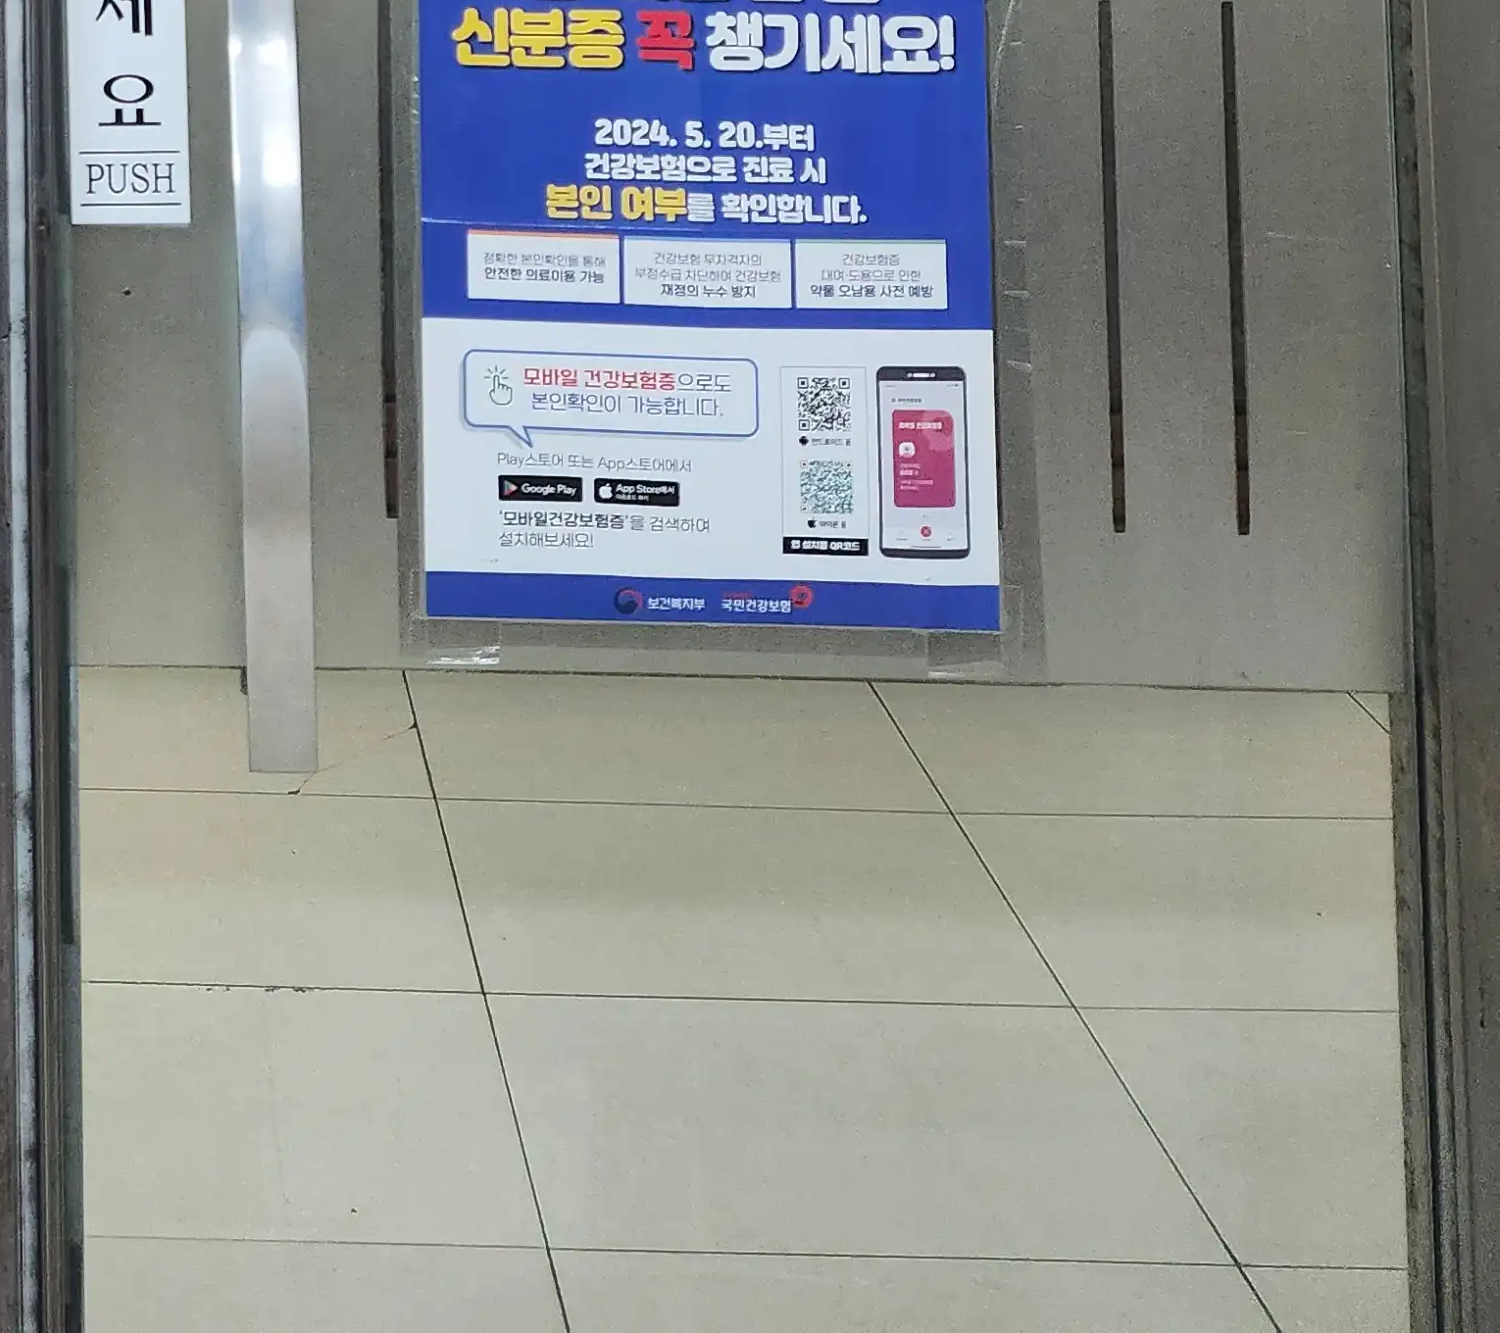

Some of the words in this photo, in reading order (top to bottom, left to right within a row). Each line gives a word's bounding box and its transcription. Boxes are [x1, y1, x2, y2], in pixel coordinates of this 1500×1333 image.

[451, 6, 625, 70] 신분증
[636, 9, 695, 72] 꼭
[705, 11, 956, 75] 챙기세요!
[584, 152, 738, 183] 건강보험으로
[742, 156, 794, 185] 진료
[801, 158, 827, 185] 시
[85, 161, 177, 195] PUSH
[545, 183, 613, 220] 본인
[620, 186, 716, 223] 여부를
[720, 193, 869, 225] 확인합니다.
[484, 267, 522, 281] 안전한
[526, 268, 575, 283] 의료이용
[580, 270, 605, 284] 가능
[660, 283, 699, 298] 재정의
[703, 285, 728, 299] 누수
[731, 285, 757, 300] 방지
[810, 284, 835, 298] 약물
[838, 284, 876, 299] 오남용
[880, 285, 905, 299] 사전
[908, 285, 934, 299] 예방
[523, 367, 579, 388] 모바일
[584, 369, 732, 394] 건강보험증으로도
[531, 392, 621, 414] 본인확인이
[627, 395, 725, 418] 가능합니다.
[497, 452, 564, 469] Play스토어
[567, 455, 595, 469] 또는
[597, 456, 693, 474] App스토어에서
[521, 482, 556, 496] Google
[557, 484, 578, 497] Play
[615, 483, 635, 495] App
[649, 516, 711, 534] 검색하여
[499, 532, 595, 550] 설치해보세요!
[647, 596, 706, 611] 보건복지부
[721, 598, 792, 614] 국민건강보험
